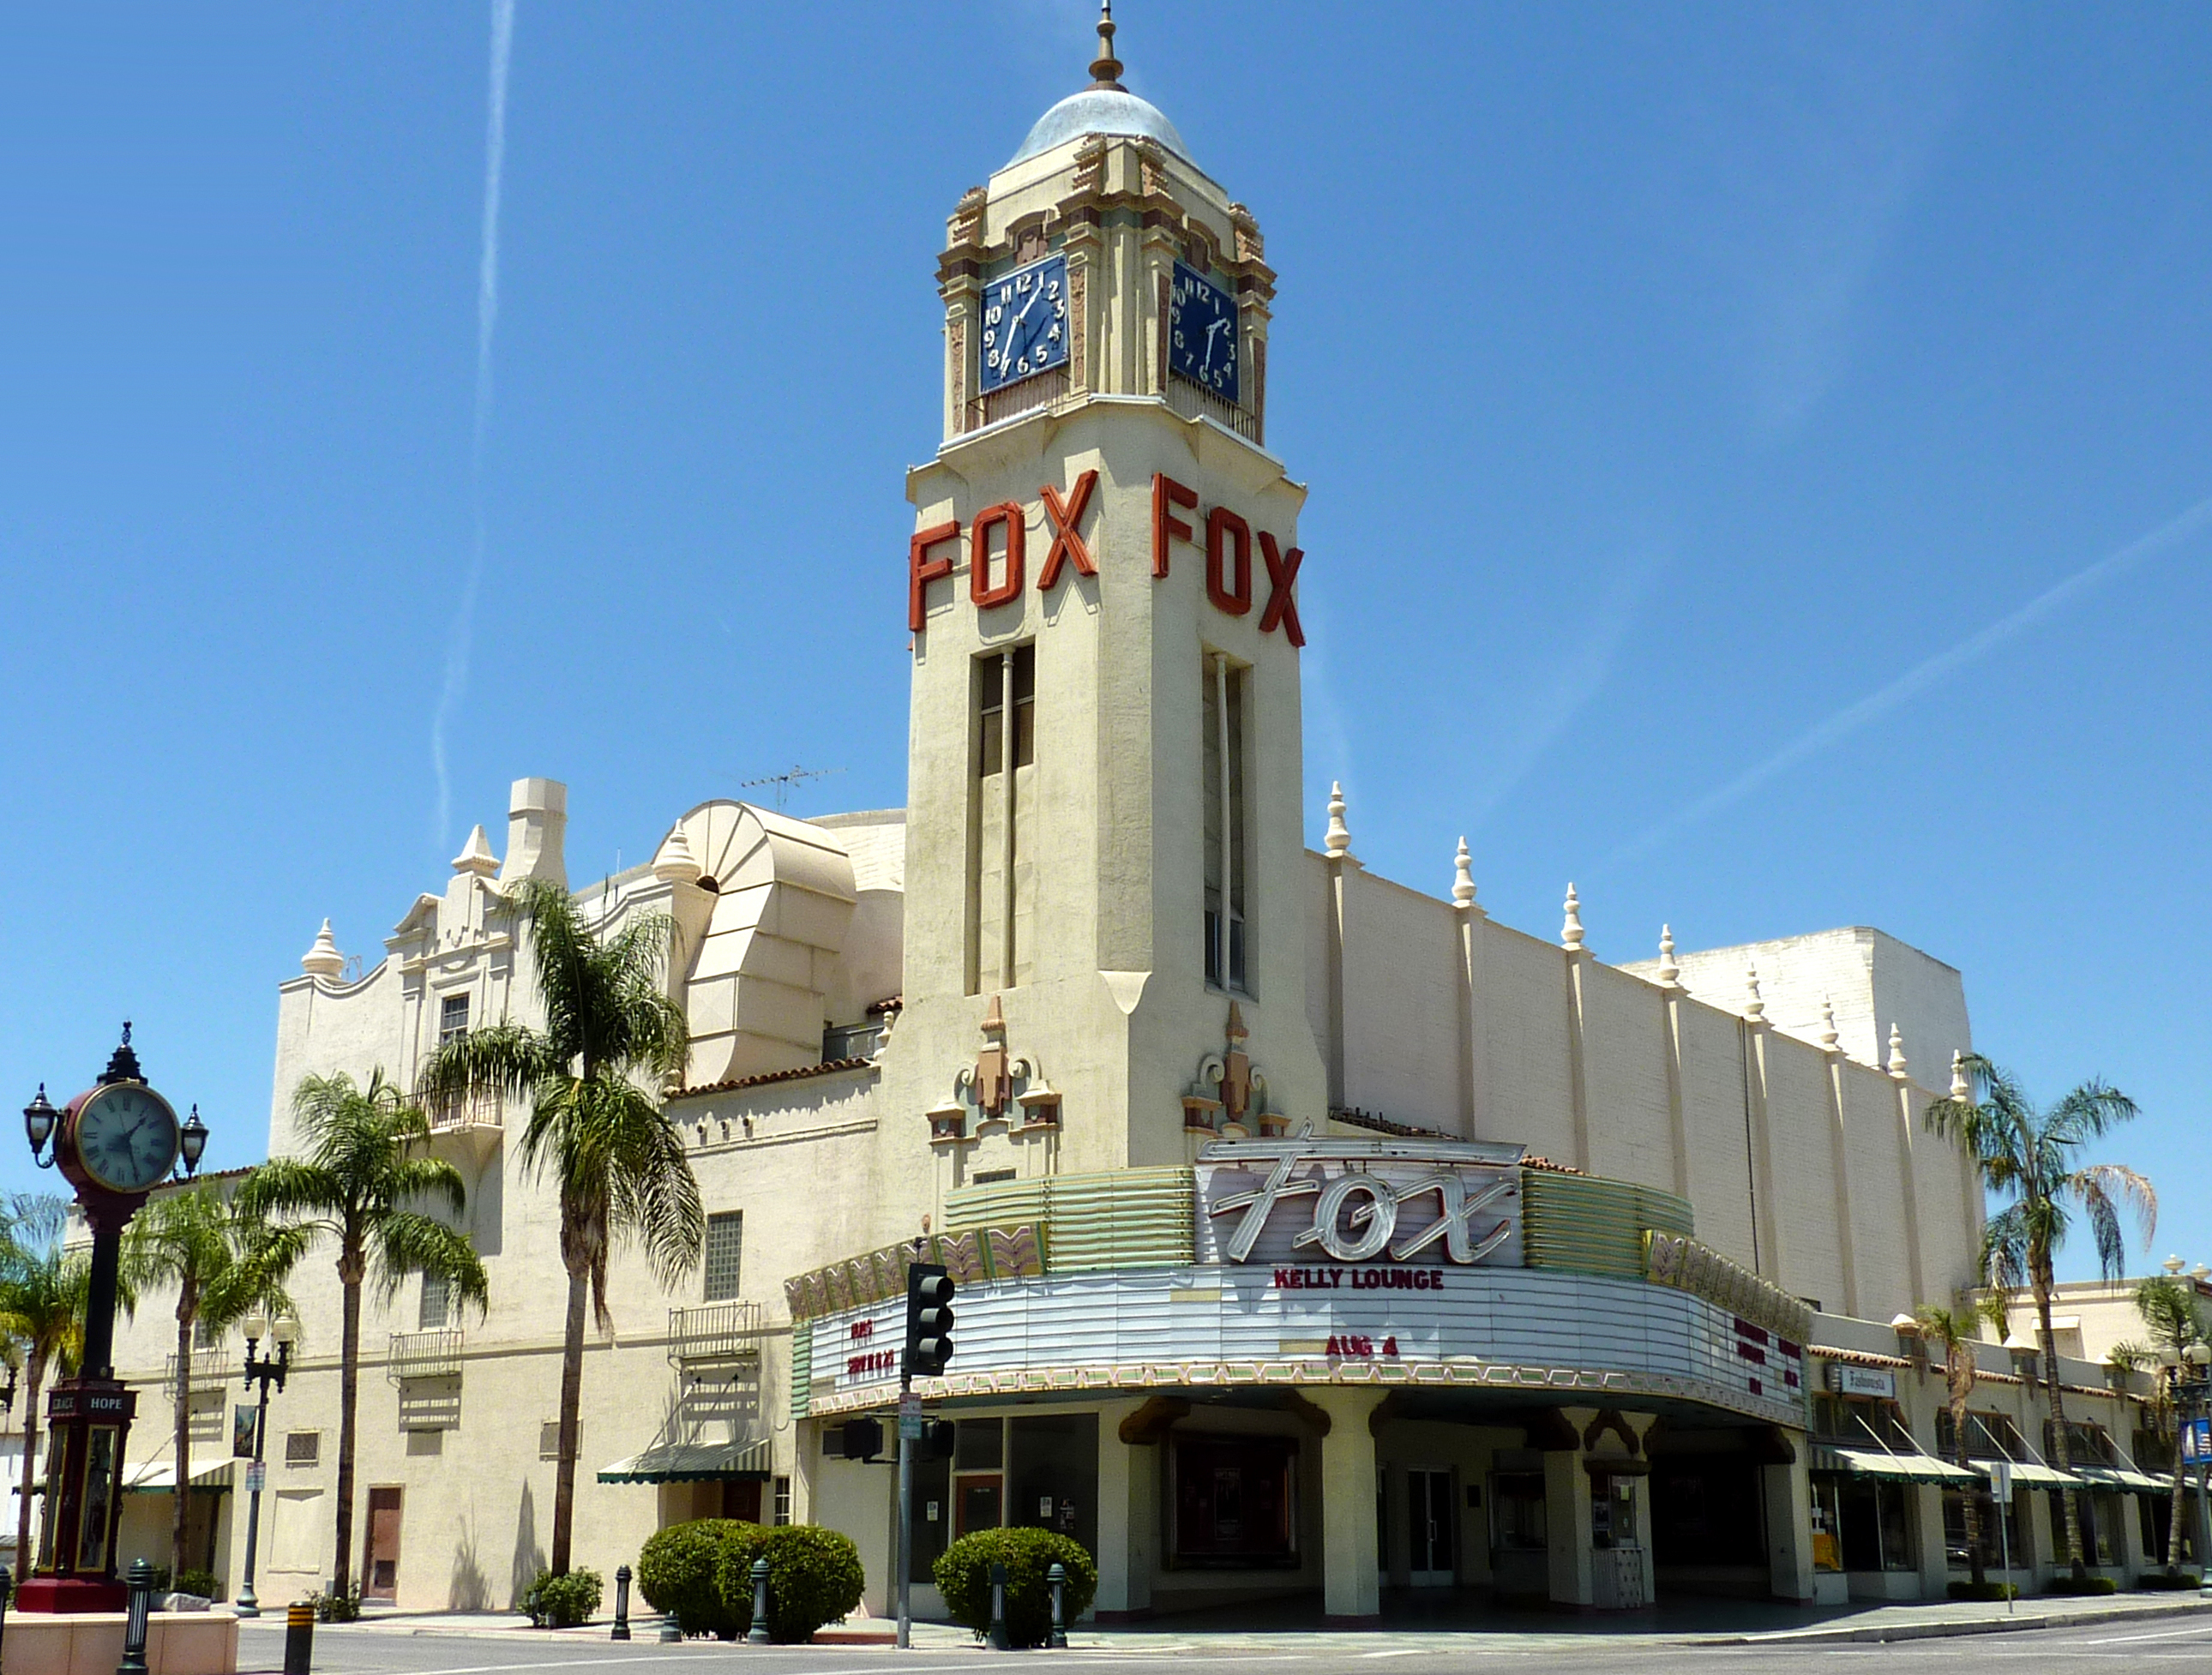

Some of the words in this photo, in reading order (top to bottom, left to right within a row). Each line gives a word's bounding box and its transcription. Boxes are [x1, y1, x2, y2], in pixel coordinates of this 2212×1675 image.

[1017, 273, 1031, 294] 12
[1049, 280, 1059, 300] 2
[1197, 281, 1210, 303] 12
[1001, 285, 1012, 305] 11
[1172, 285, 1186, 307] 10
[985, 305, 1001, 327] 10
[1054, 299, 1065, 319] 3
[1171, 306, 1181, 325] 9
[983, 330, 995, 348] 9
[1048, 323, 1061, 341] 4
[1175, 330, 1184, 349] 8
[988, 349, 1000, 368] 8
[1036, 345, 1048, 363] 5
[1186, 351, 1193, 368] 7
[1227, 341, 1235, 361] 3
[1017, 356, 1029, 374] 6
[1199, 364, 1209, 382] 6
[1223, 362, 1231, 379] 4
[1214, 369, 1223, 387] 5
[909, 469, 1099, 632] FOX
[1151, 472, 1306, 648] FOX
[1274, 1268, 1343, 1289] KELLY
[1352, 1269, 1445, 1290] LOUNGE
[1325, 1335, 1373, 1356] AUG
[1382, 1336, 1398, 1356] 4
[90, 1397, 123, 1409] HOPE
